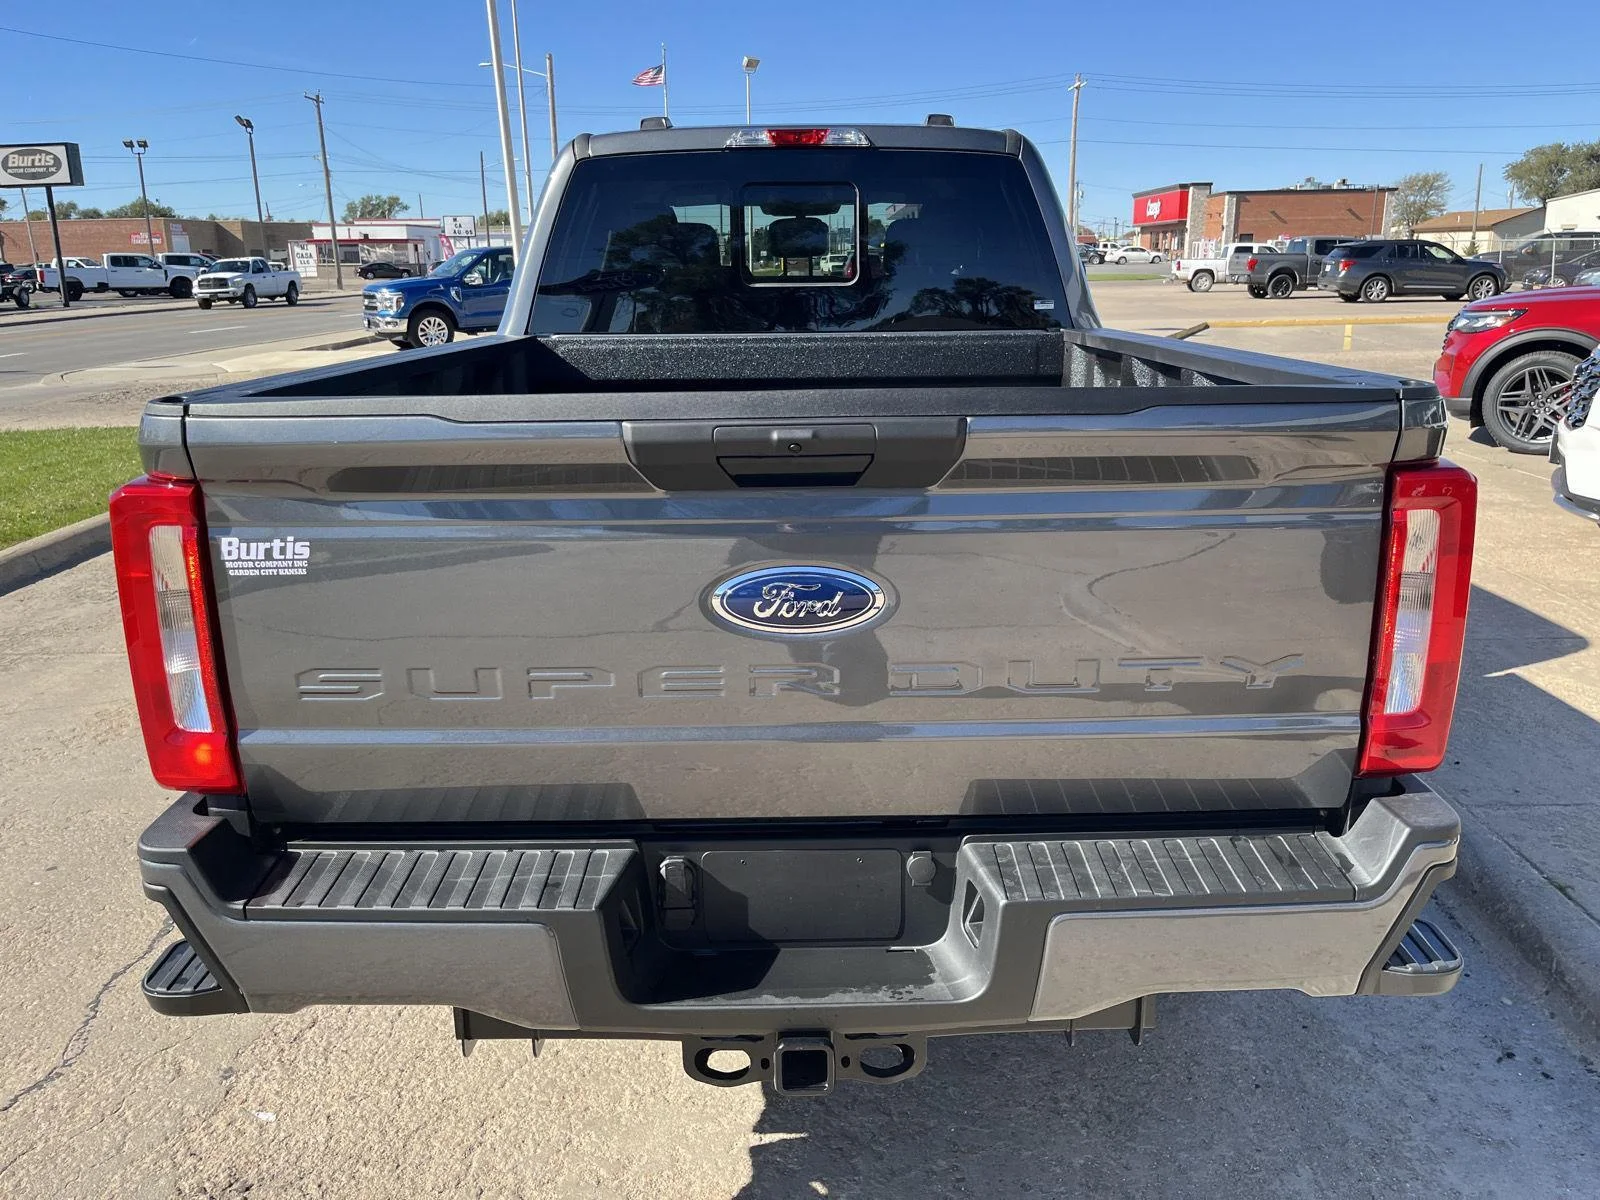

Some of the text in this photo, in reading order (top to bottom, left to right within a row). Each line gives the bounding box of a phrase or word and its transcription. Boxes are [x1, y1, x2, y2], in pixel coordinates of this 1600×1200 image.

[8, 153, 55, 167] Burtis
[221, 536, 310, 560] Burtis
[278, 568, 307, 576] KANSAS
[753, 582, 844, 618] Ford
[295, 653, 1304, 701] SUPER DUTY
